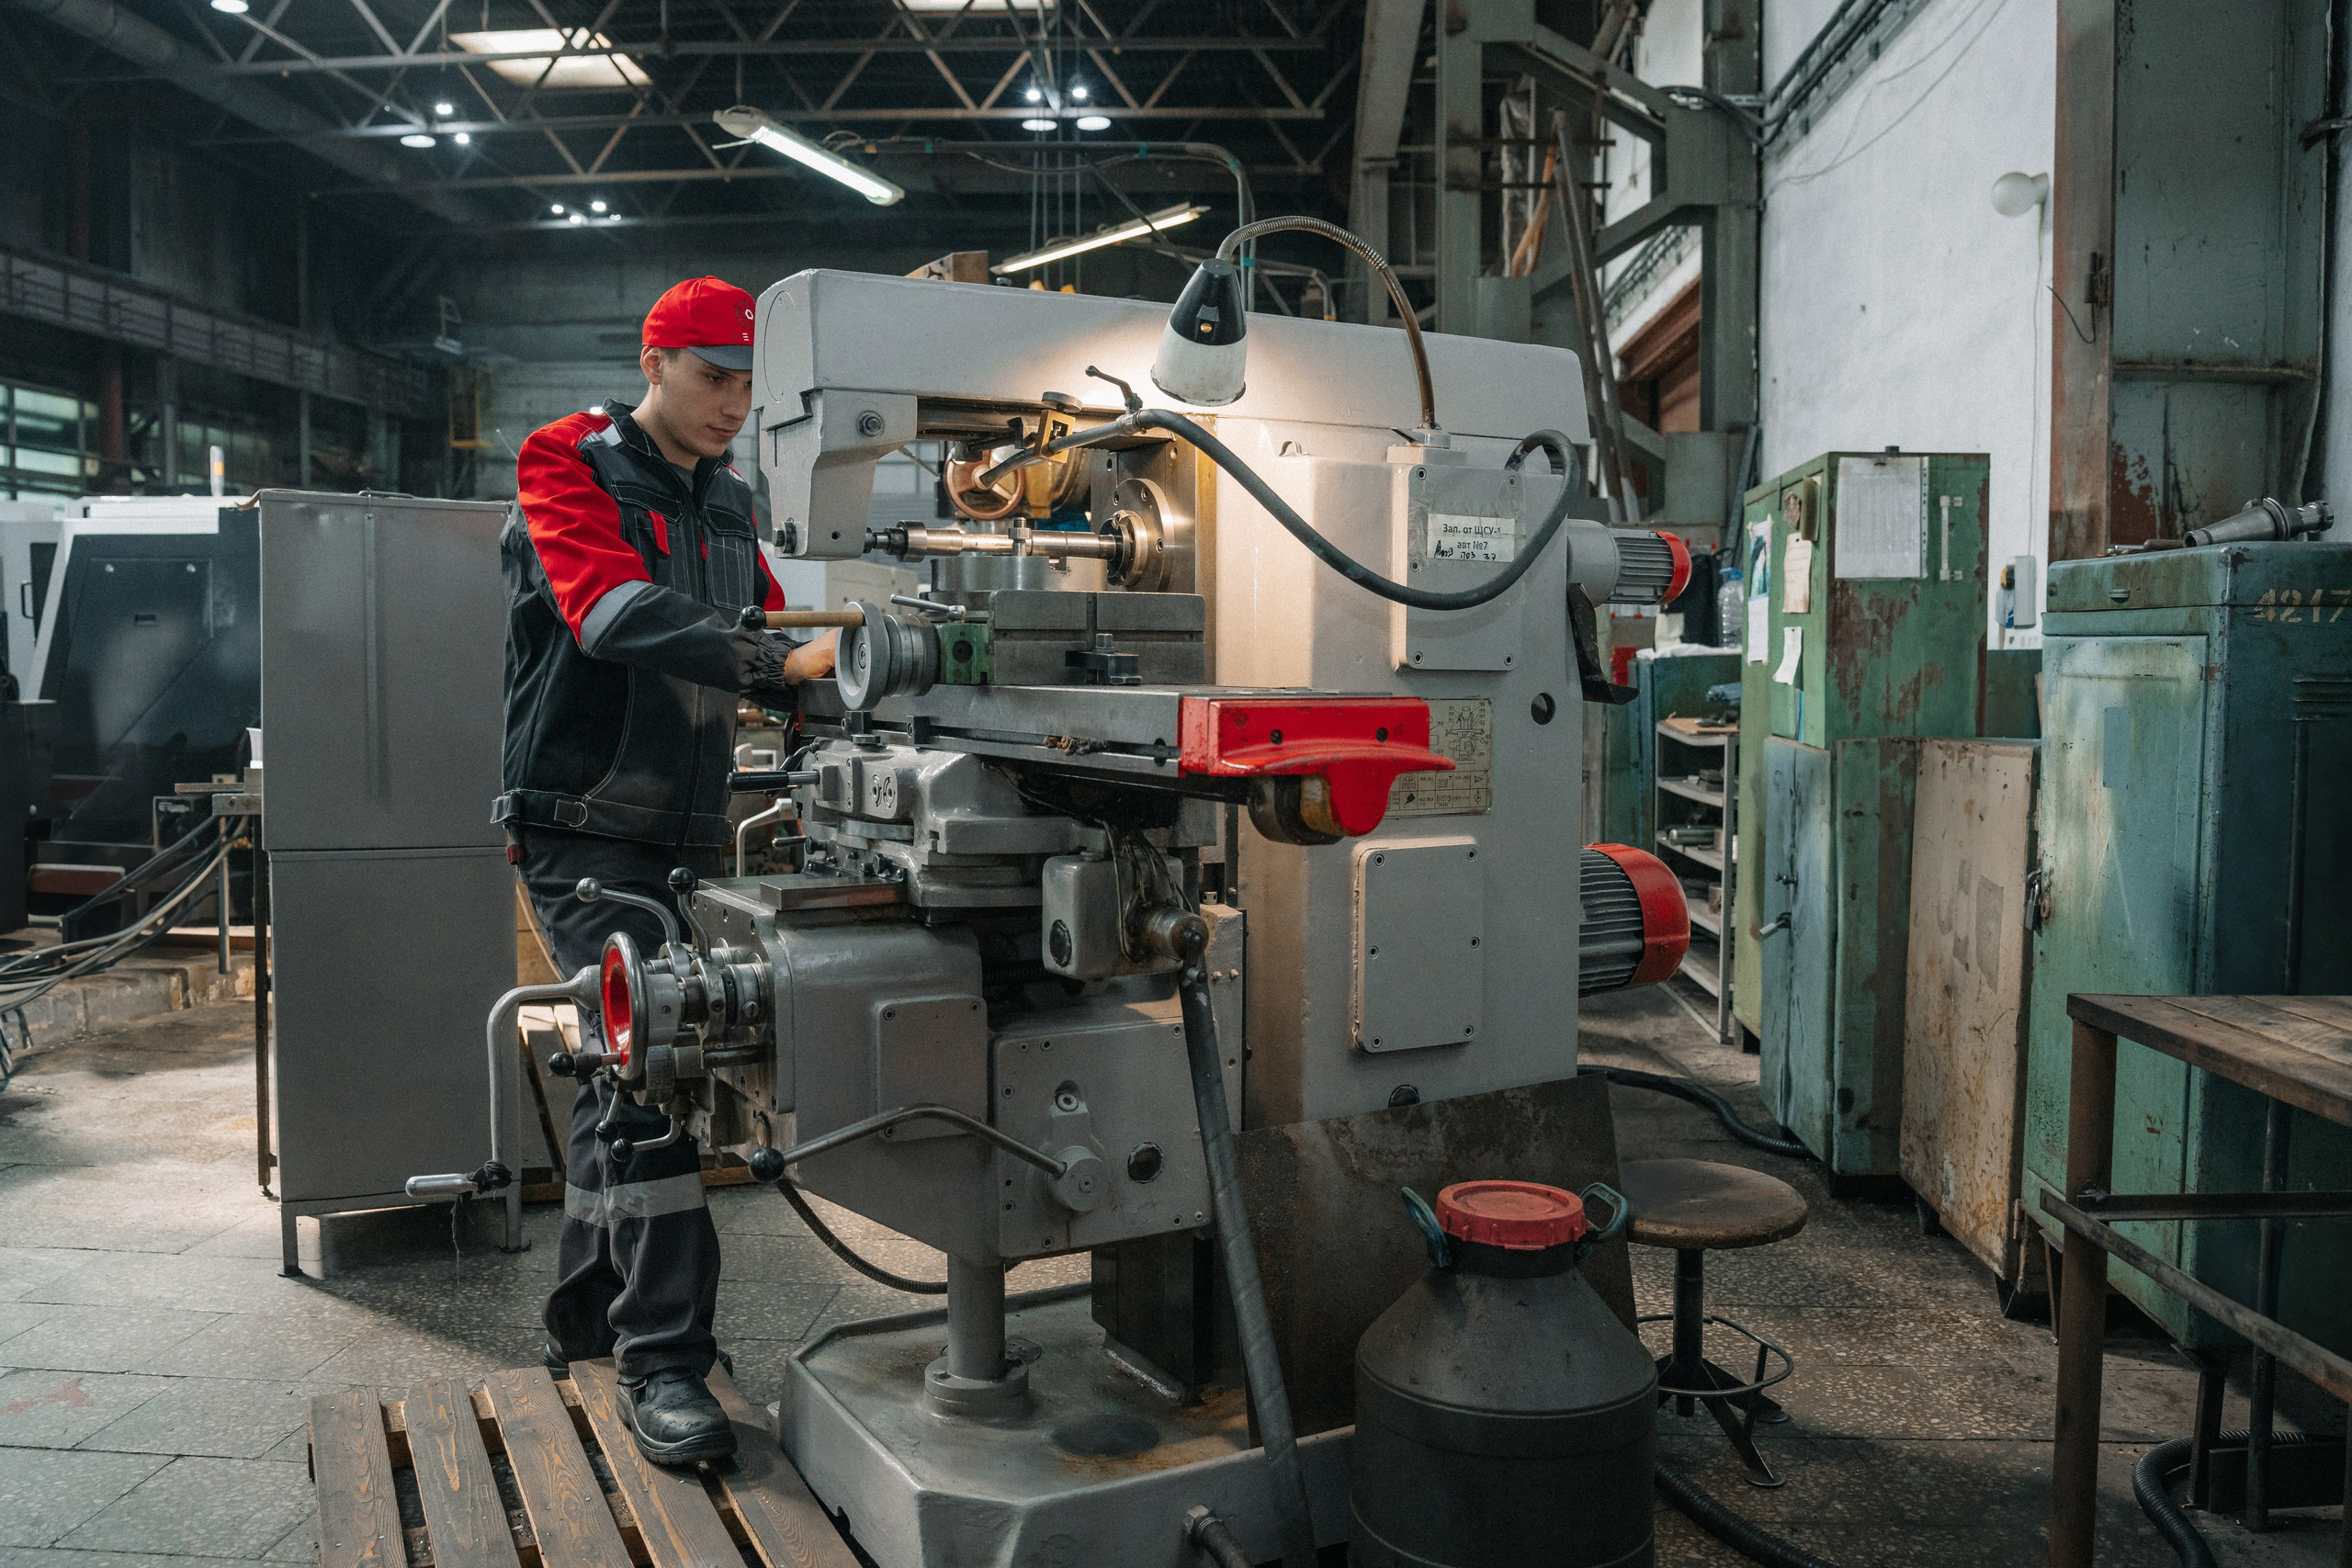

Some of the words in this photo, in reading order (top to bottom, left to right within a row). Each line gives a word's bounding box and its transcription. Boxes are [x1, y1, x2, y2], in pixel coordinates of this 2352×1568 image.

[1443, 524, 1461, 534] Зап.
[1475, 525, 1501, 536] ЩСУ-1
[1457, 541, 1471, 549] авт
[1473, 541, 1488, 550] №7
[2253, 588, 2351, 623] 4217
